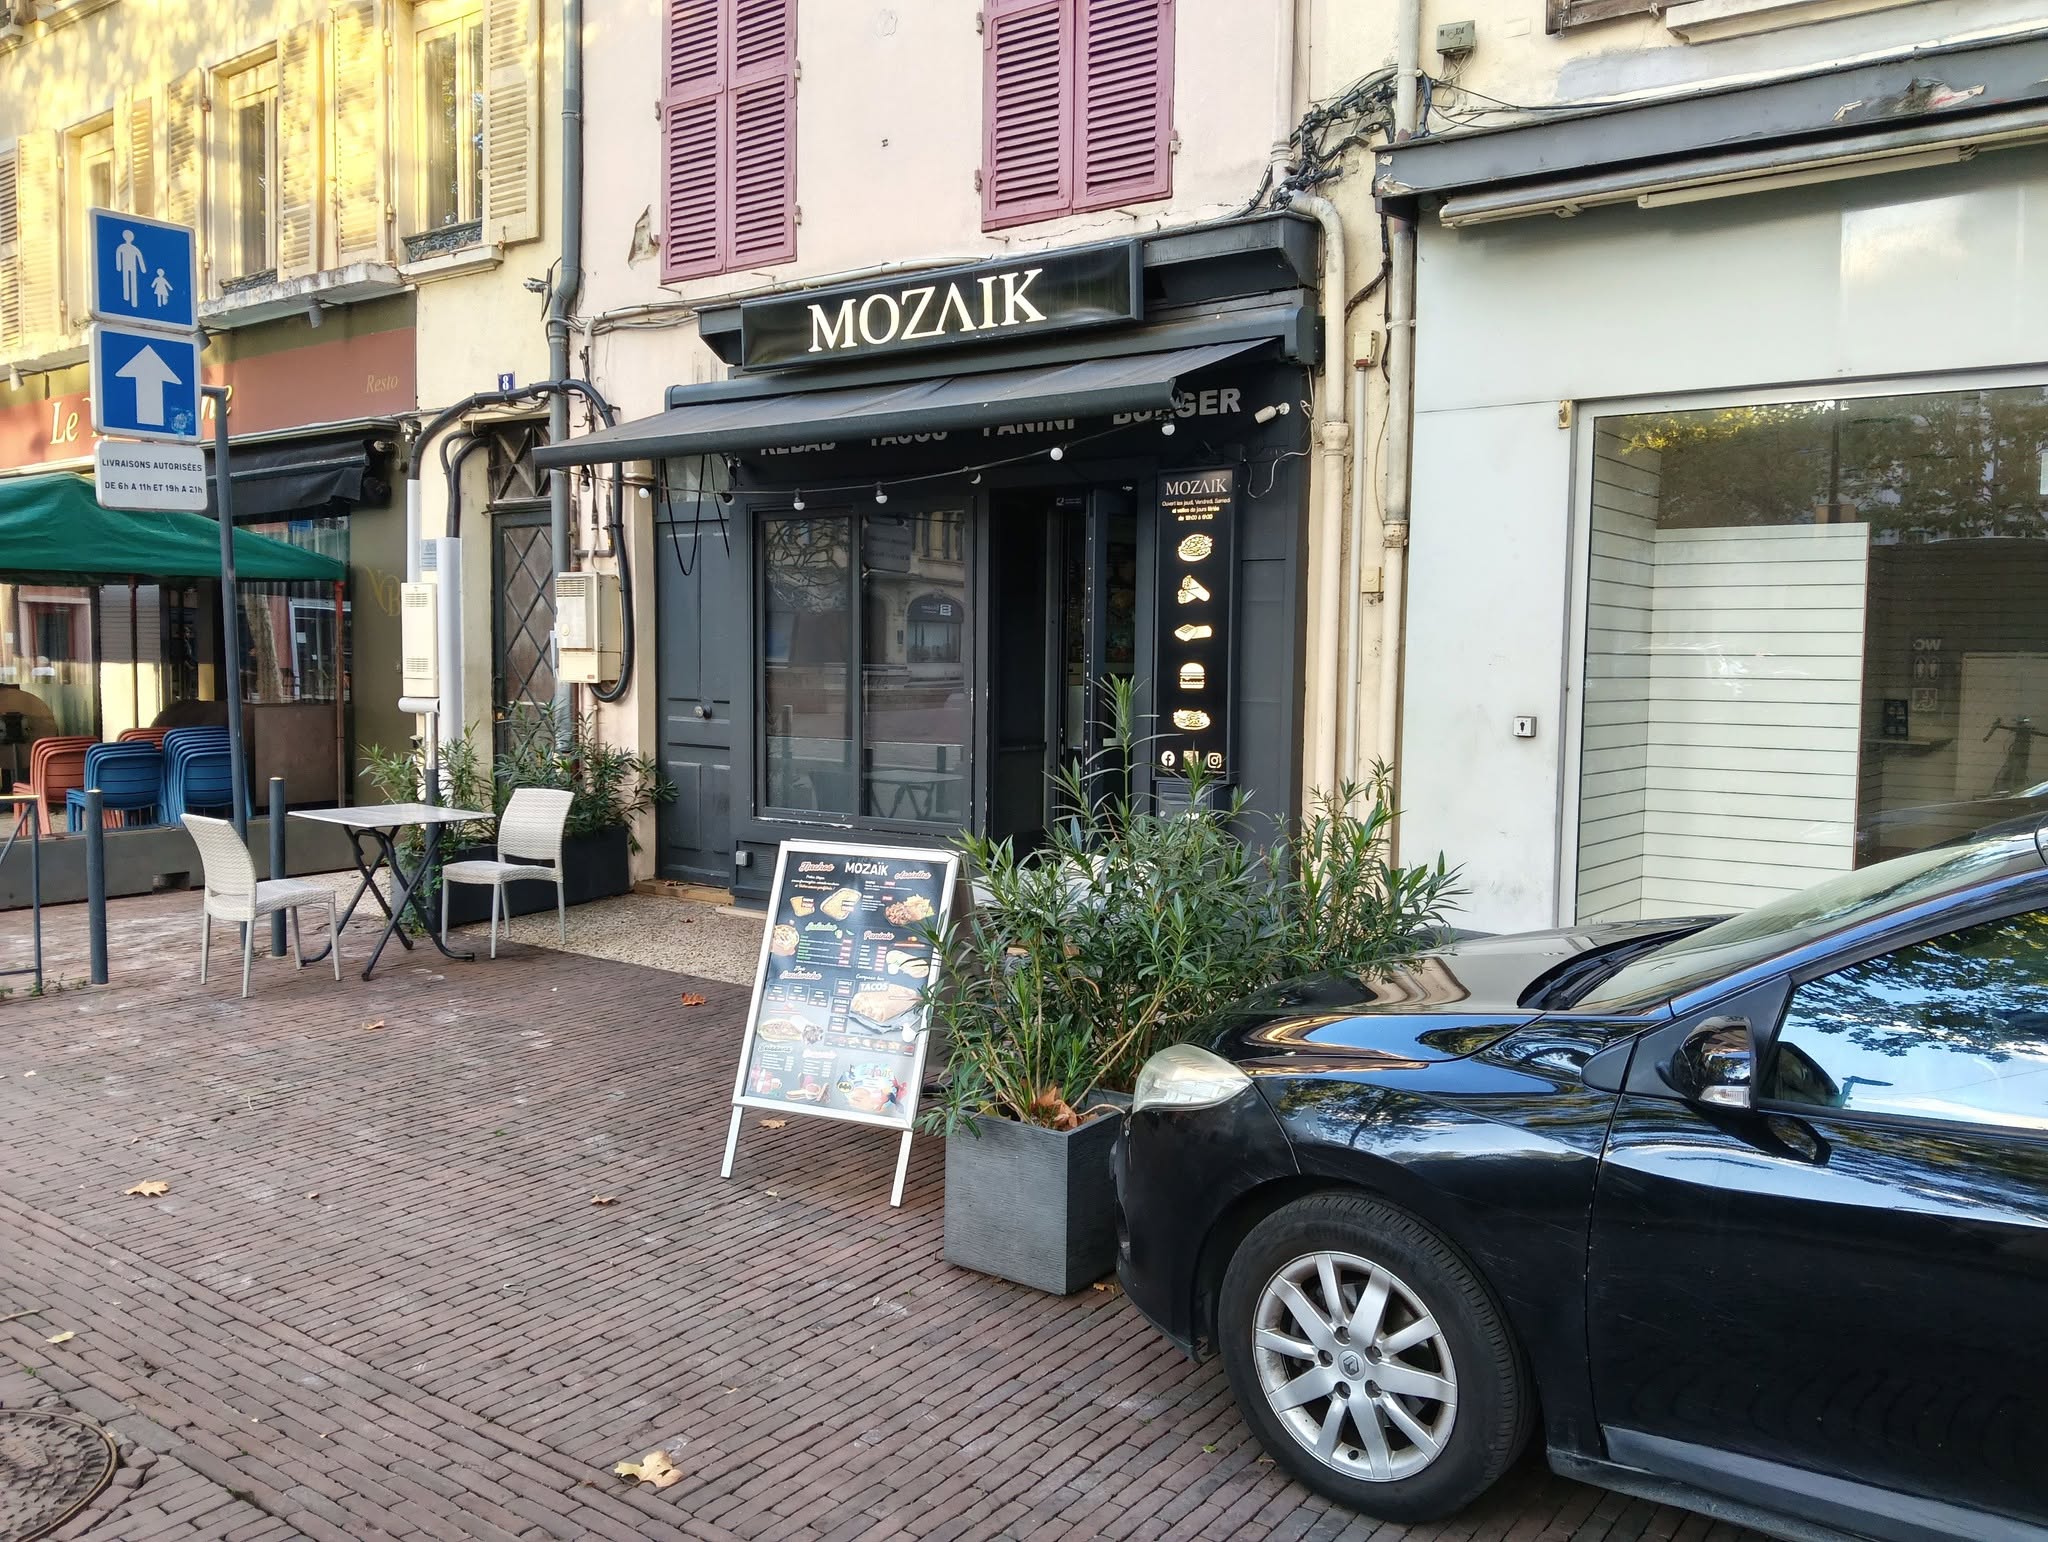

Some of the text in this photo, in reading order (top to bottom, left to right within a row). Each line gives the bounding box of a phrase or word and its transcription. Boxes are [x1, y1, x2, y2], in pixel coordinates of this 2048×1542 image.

[366, 374, 399, 393] Resto
[502, 376, 510, 391] 8
[50, 401, 80, 445] Le
[102, 458, 202, 472] LIVRAISONS AUTORISÉES
[104, 481, 203, 494] DE 6h A 11h ET 19h A 21h
[844, 861, 889, 876] MOZAÏK
[860, 982, 889, 992] TACOS
